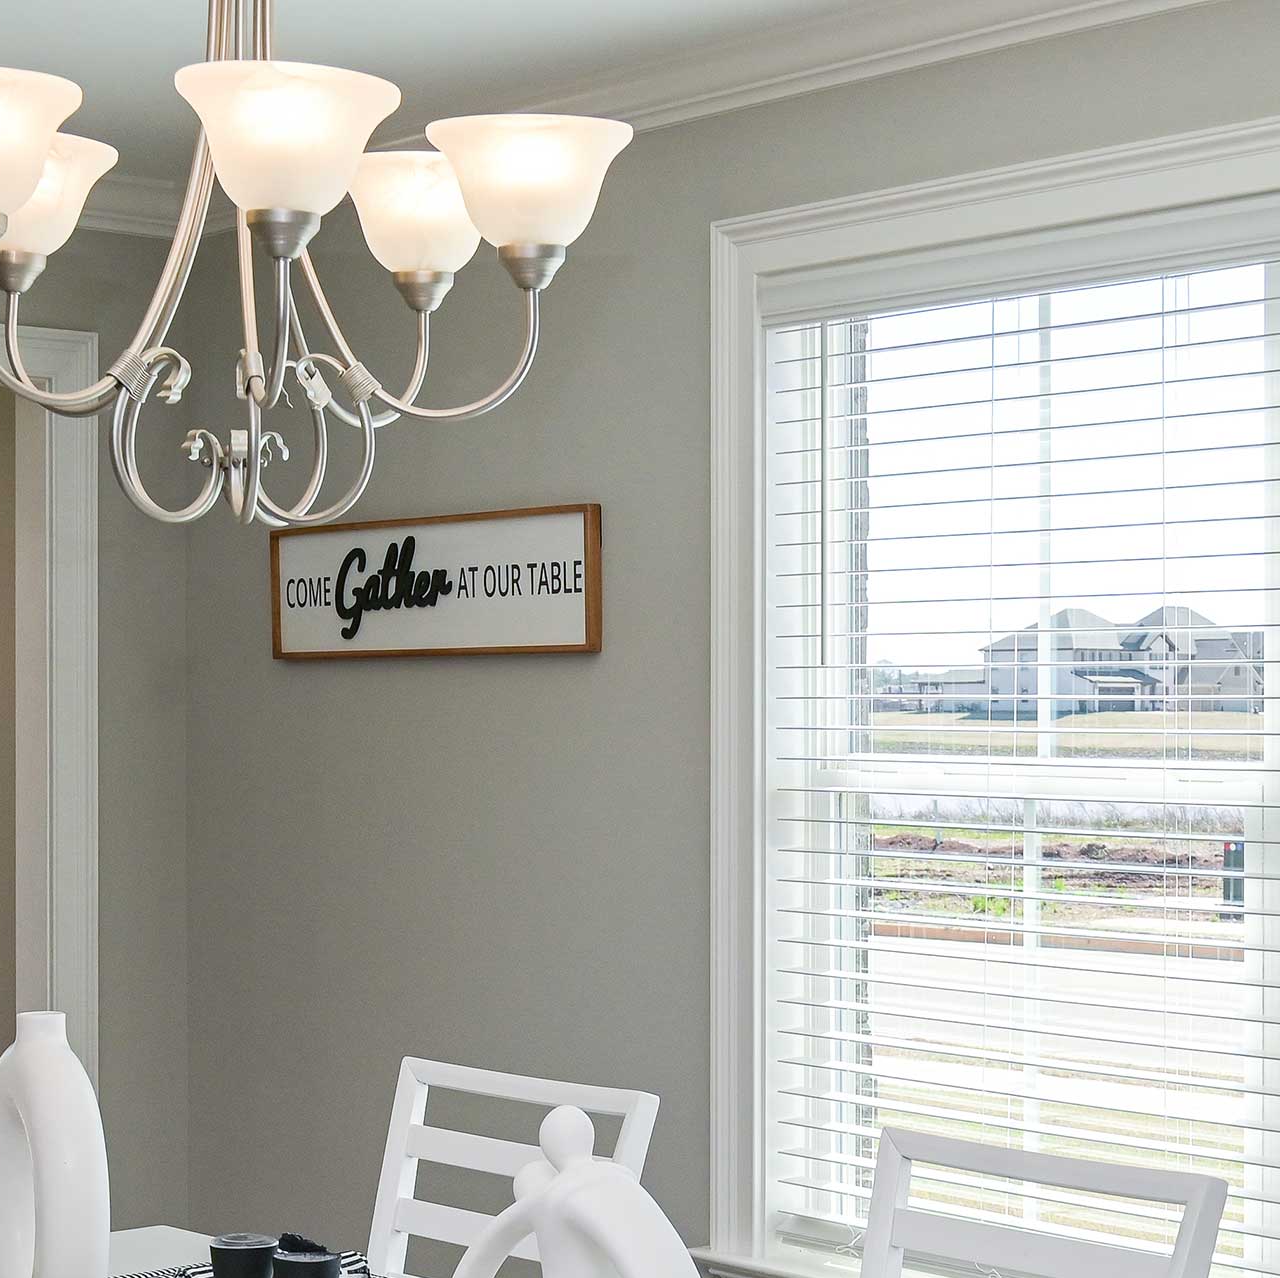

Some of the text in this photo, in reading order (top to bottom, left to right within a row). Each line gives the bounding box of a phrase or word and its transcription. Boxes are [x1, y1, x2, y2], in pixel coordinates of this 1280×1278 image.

[286, 535, 583, 640] COME Gather AT OUR TABLE
